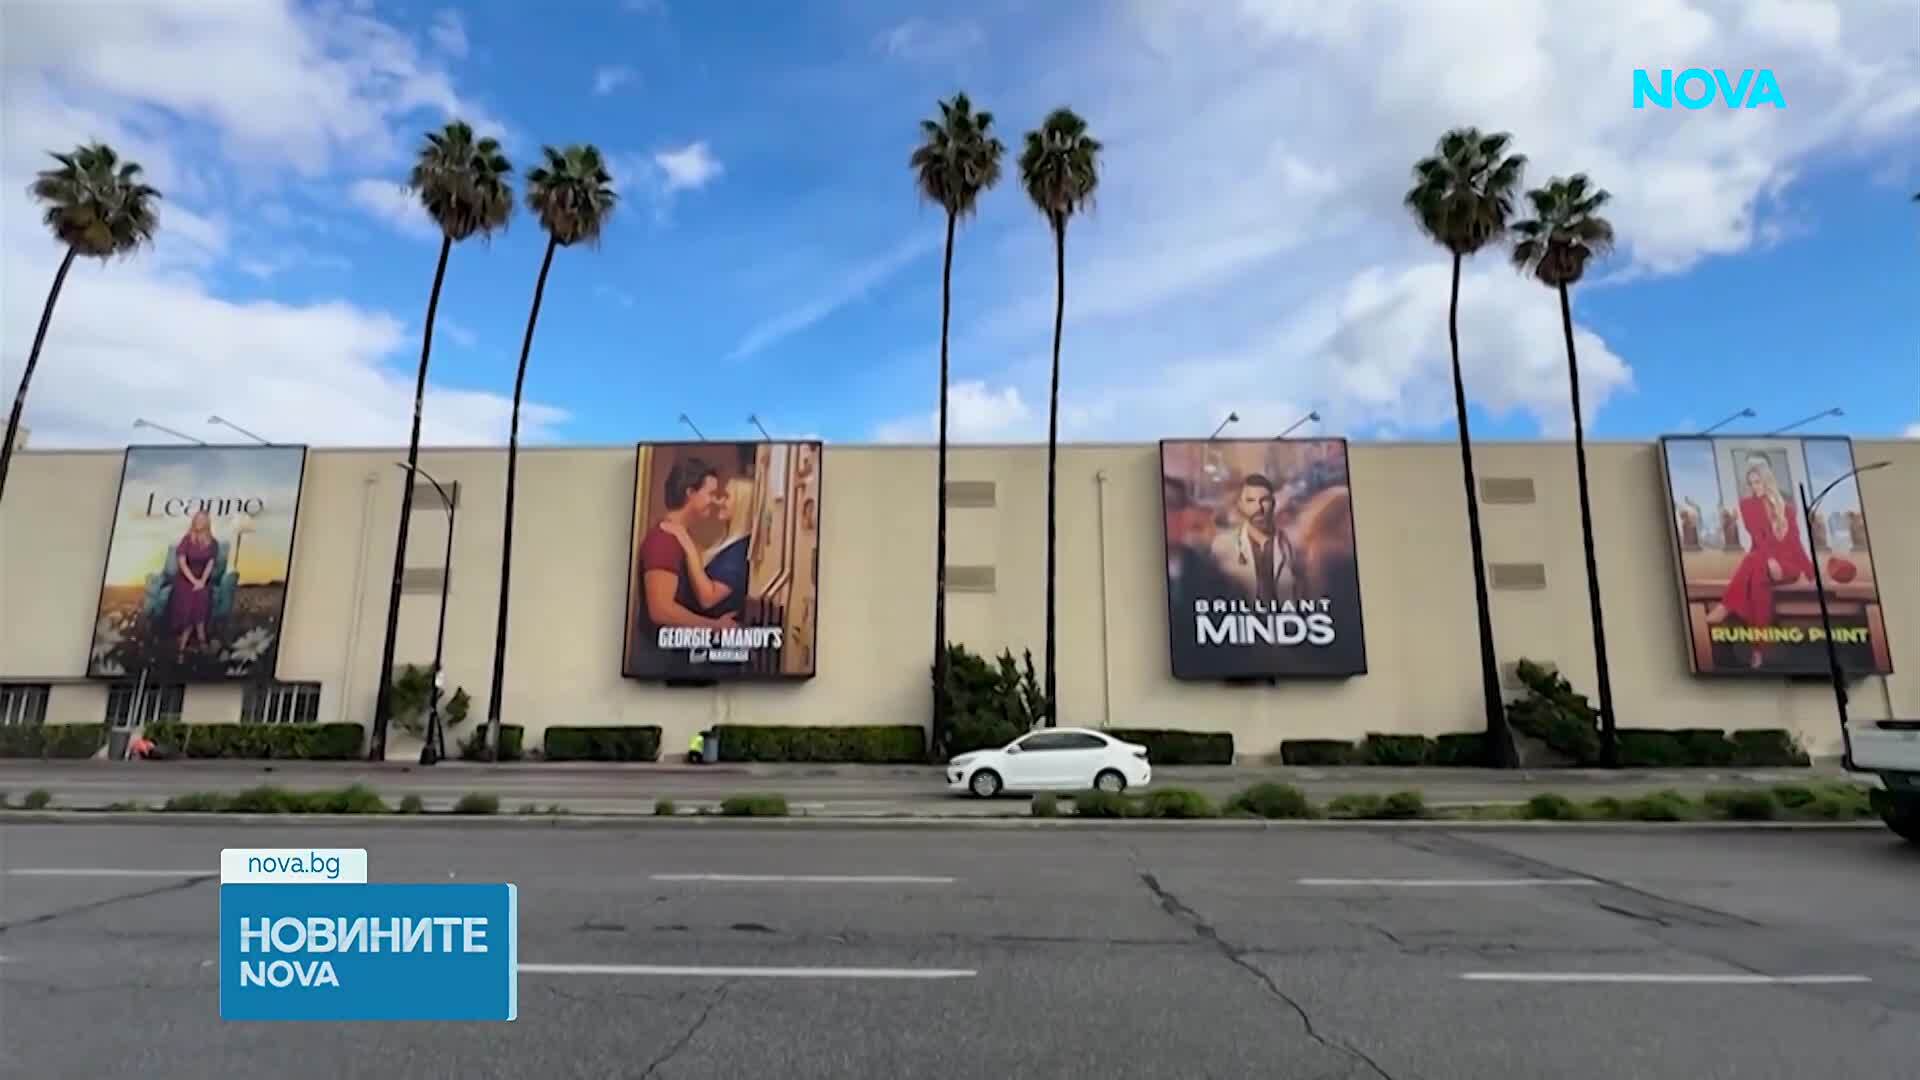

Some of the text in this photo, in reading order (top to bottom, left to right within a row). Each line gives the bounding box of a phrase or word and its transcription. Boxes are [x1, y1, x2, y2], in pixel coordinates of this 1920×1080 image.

[1195, 599, 1331, 612] BRILLIANT
[658, 627, 712, 648] GEORGIE
[721, 627, 783, 649] MANDY'S
[1196, 613, 1335, 644] MINDS
[1711, 627, 1803, 643] RUNNING
